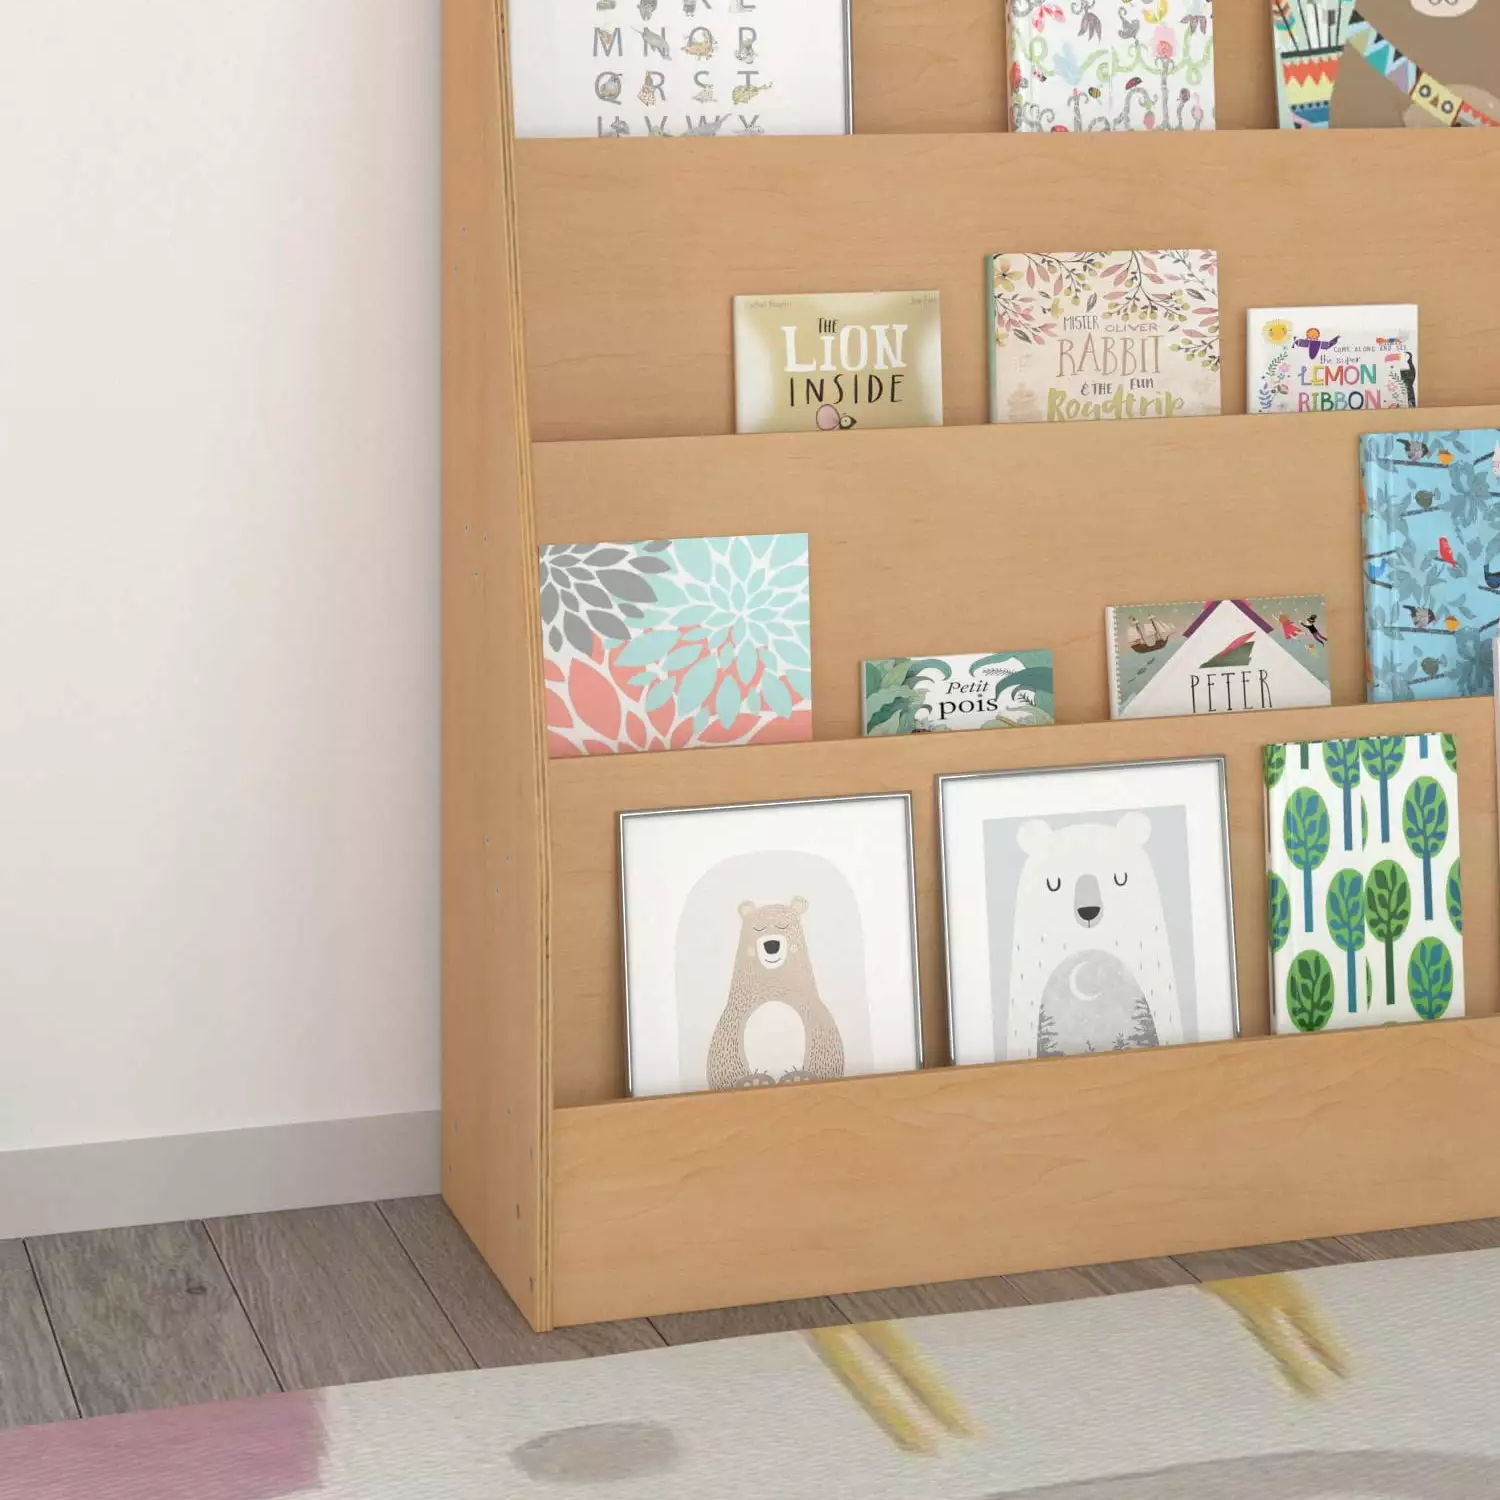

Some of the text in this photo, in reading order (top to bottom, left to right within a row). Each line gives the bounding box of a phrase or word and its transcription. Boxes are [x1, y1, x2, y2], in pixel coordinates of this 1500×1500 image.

[593, 27, 623, 57] M
[594, 71, 623, 105] Q
[816, 317, 839, 334] THE
[1063, 314, 1160, 333] MISTER OLIVER
[781, 323, 909, 372] LION
[1056, 332, 1164, 377] RABBIT
[1298, 363, 1377, 386] LEMON
[789, 374, 905, 407] INSIDE
[1046, 383, 1185, 421] Roadtrip
[1091, 382, 1112, 396] THE
[1298, 388, 1382, 412] RIBBON
[945, 680, 991, 695] Petit
[1189, 669, 1273, 714] PETER
[938, 694, 999, 720] pois
